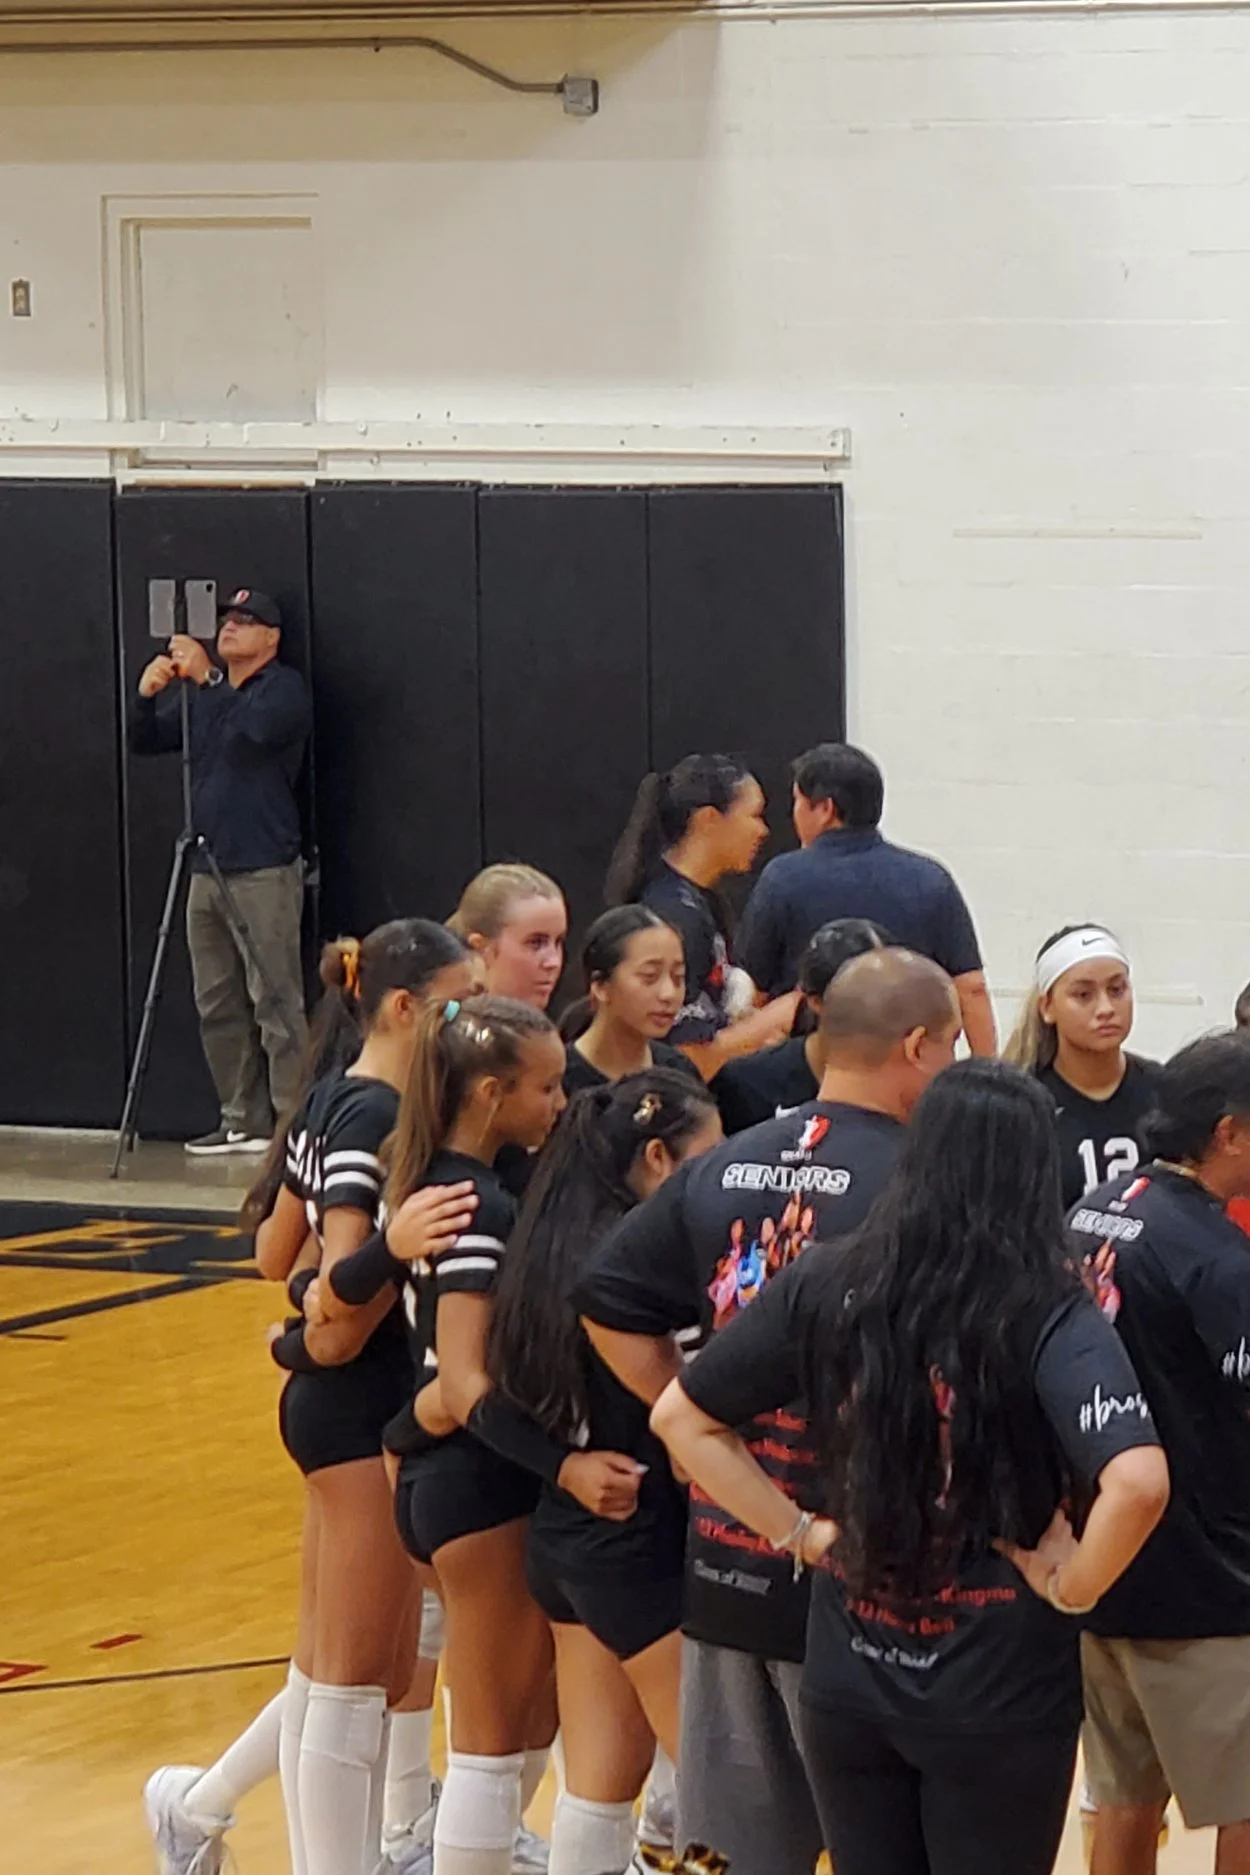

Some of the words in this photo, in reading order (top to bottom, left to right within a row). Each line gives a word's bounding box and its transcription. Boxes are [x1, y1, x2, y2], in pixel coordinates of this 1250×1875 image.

[722, 1163, 851, 1196] SENIORS
[1077, 1136, 1140, 1198] 12
[1079, 1382, 1150, 1433] #bros
